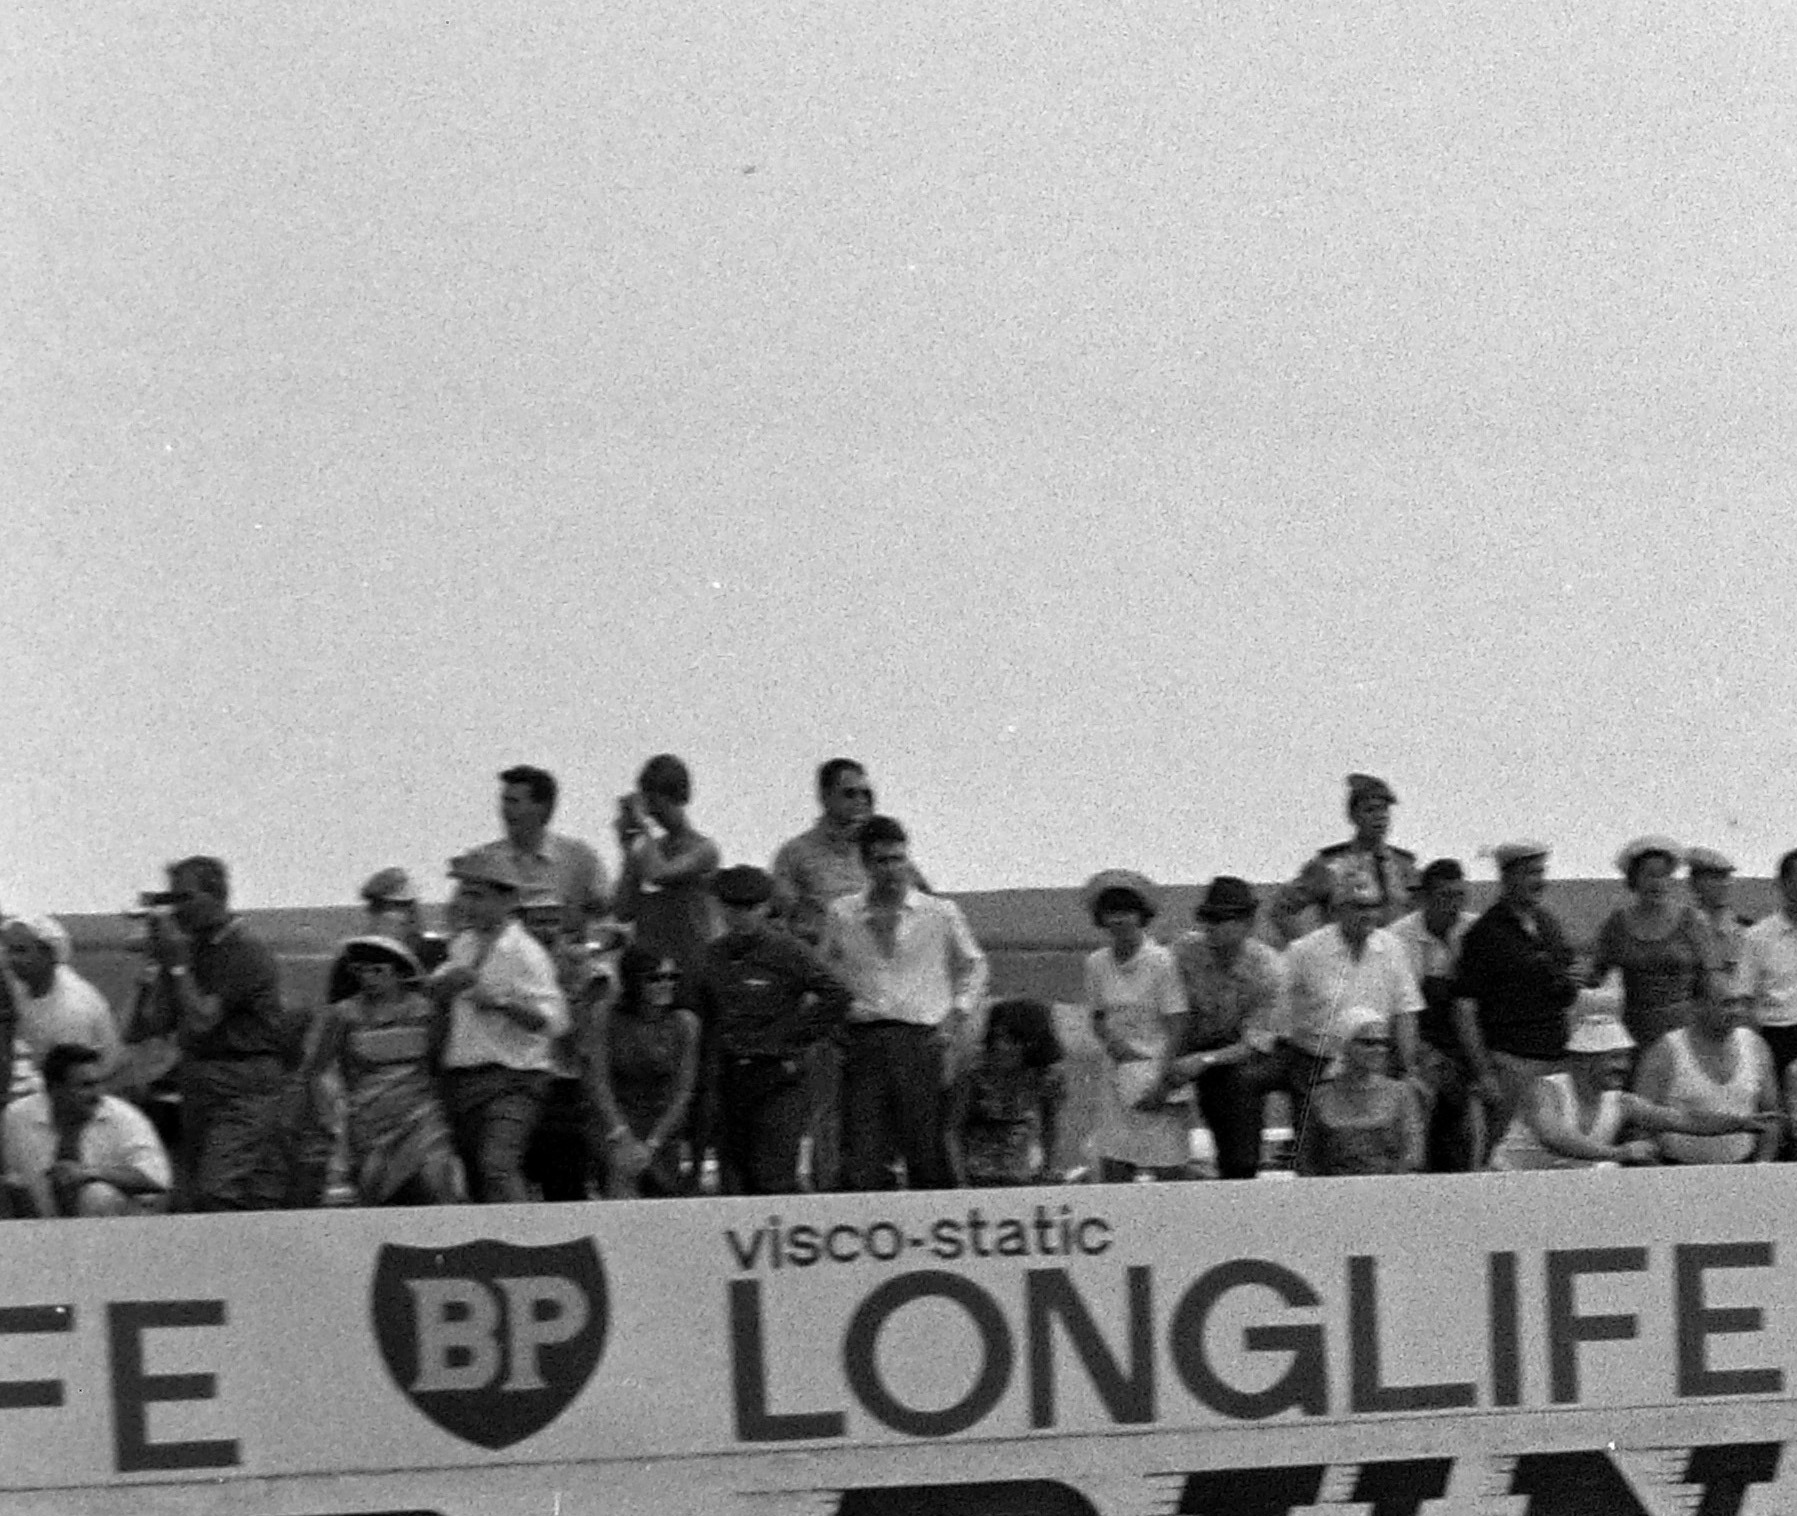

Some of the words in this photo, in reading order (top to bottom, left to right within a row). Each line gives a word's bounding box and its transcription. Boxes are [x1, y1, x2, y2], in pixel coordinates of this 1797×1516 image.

[724, 1204, 1112, 1270] visco-static
[406, 1275, 590, 1392] BP
[728, 1242, 1784, 1442] LONGLIFE
